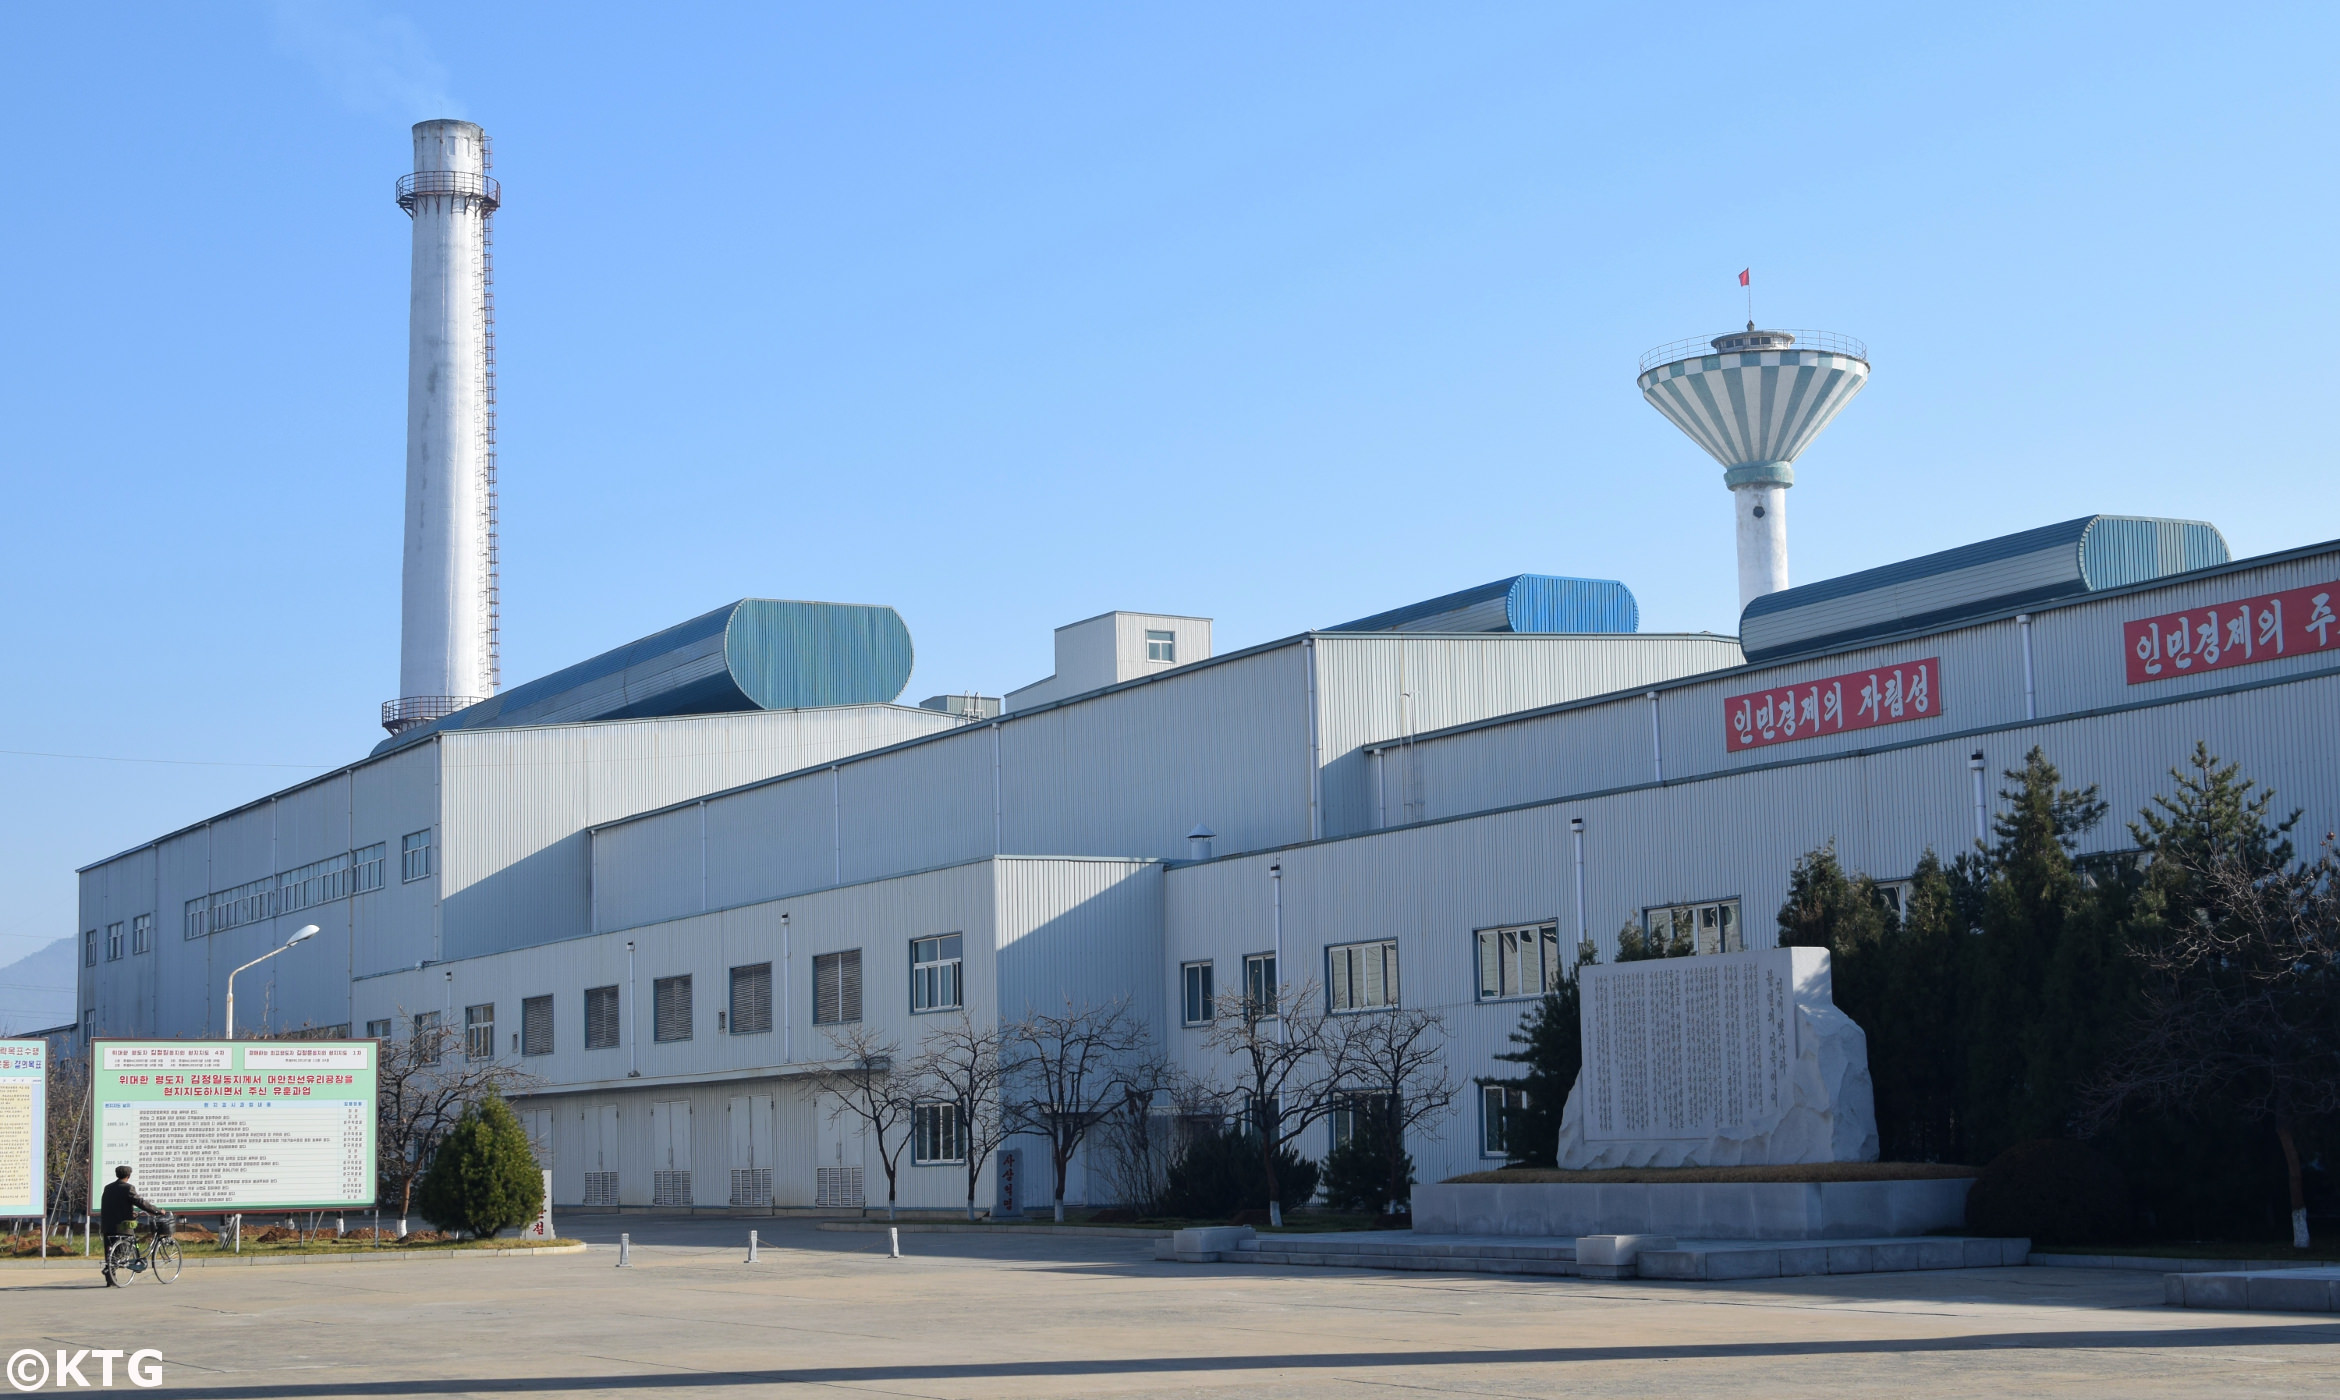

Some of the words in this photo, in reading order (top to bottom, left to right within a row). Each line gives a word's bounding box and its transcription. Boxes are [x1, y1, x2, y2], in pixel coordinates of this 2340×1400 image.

[2136, 598, 2284, 676] 인민경제의
[2304, 592, 2340, 648] 주
[1733, 681, 1843, 745] 인민경제의
[1857, 664, 1929, 723] 자립성
[120, 1076, 148, 1084] 위대한
[155, 1076, 184, 1084] 령도자
[191, 1075, 262, 1084] 김정일동지께서
[268, 1075, 353, 1084] 대안친선유리공장을
[164, 1087, 242, 1096] 현지지도하시면서
[248, 1086, 267, 1096] 주신
[273, 1086, 311, 1096] 유훈과업
